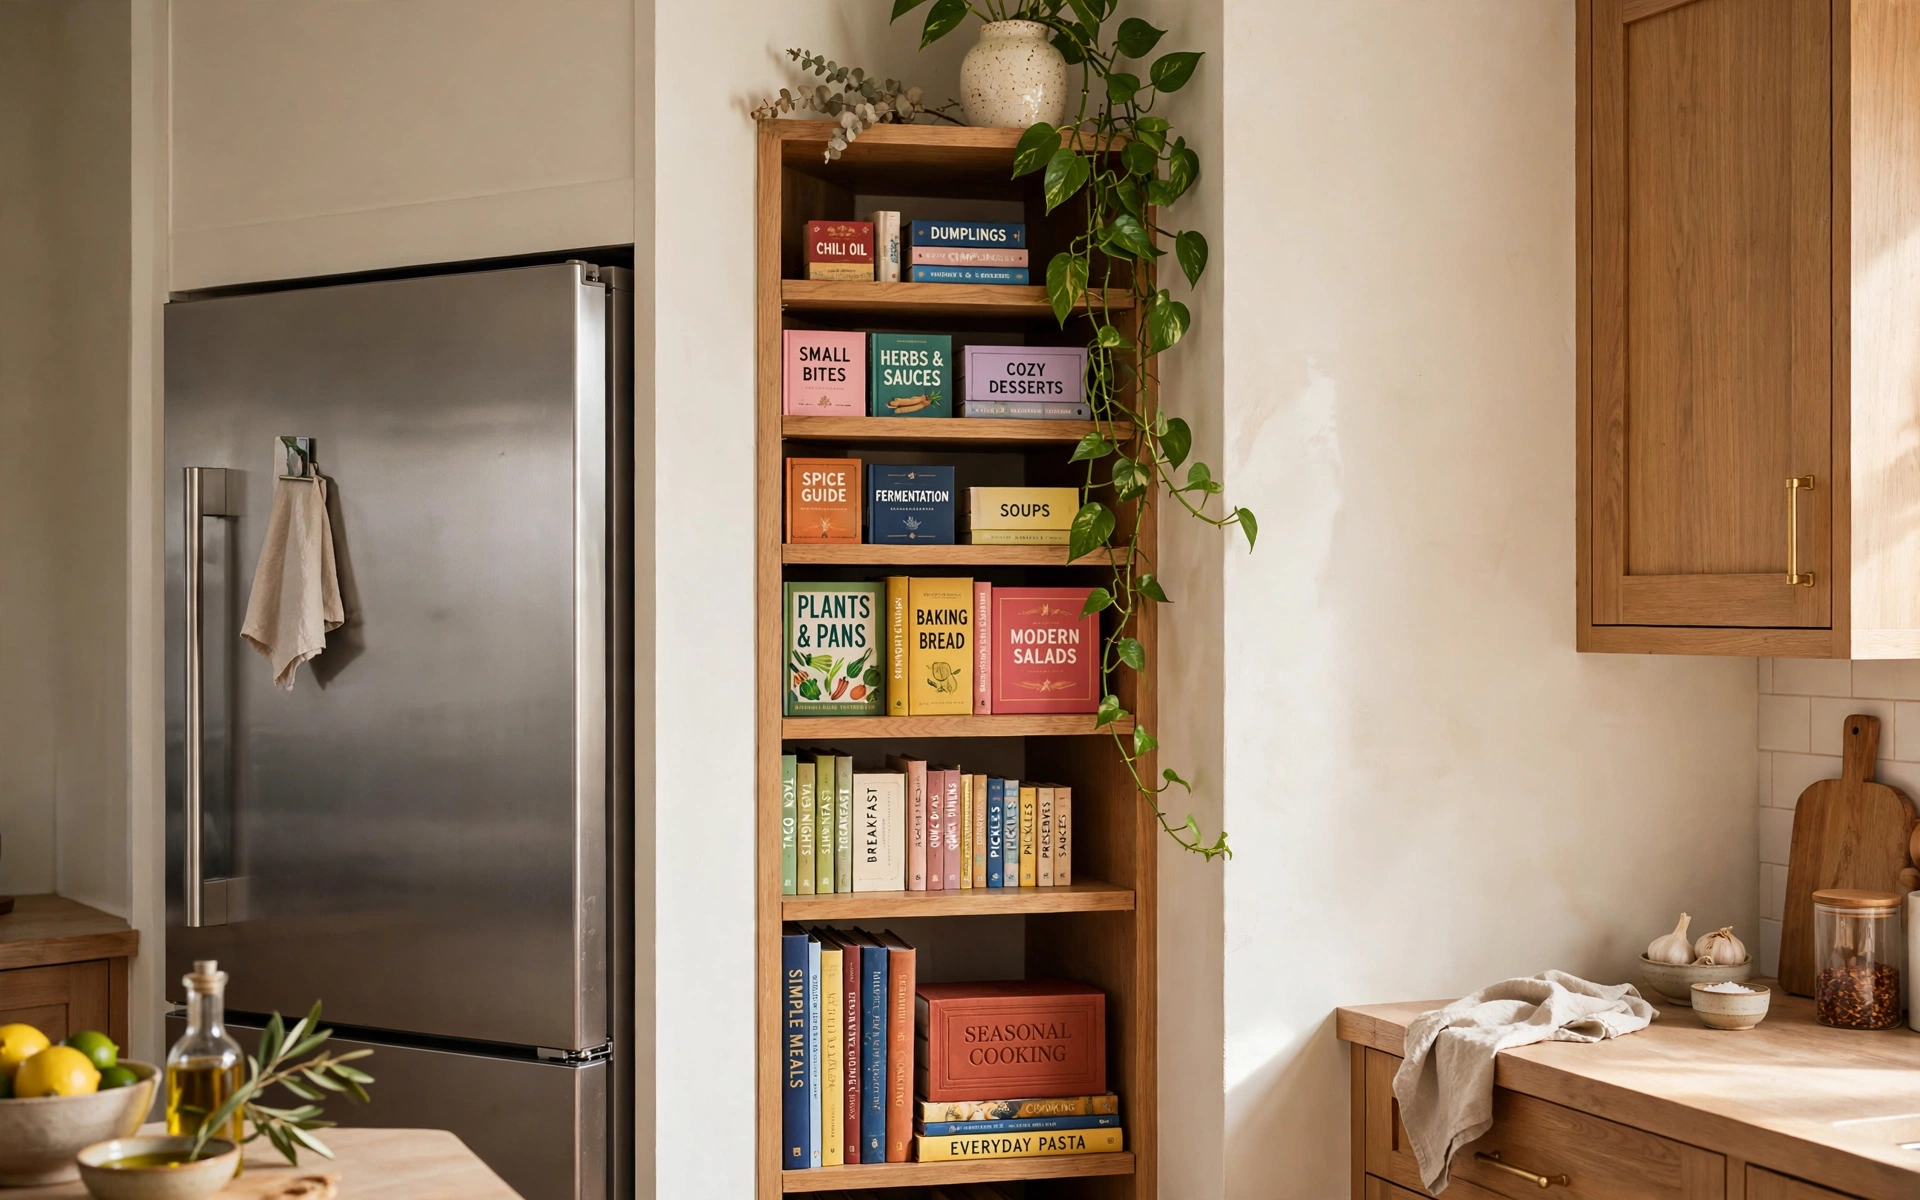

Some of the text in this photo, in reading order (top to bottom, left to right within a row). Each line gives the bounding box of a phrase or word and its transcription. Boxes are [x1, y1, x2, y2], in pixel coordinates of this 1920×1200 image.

[930, 226, 1007, 243] DUMPLINGS
[816, 241, 868, 257] CHILI OIL
[799, 346, 851, 363] SMALL
[880, 350, 944, 367] HERBS &
[802, 367, 846, 382] BITES
[883, 369, 941, 387] SAUCES
[1006, 362, 1046, 377] COZY
[989, 380, 1063, 395] DESSERTS
[802, 472, 846, 487] SPICE
[801, 488, 847, 503] GUIDE
[875, 489, 949, 503] FERMENTATION
[1000, 503, 1050, 518] SOUPS
[797, 594, 870, 620] PLANTS
[916, 609, 968, 626] BAKING
[797, 623, 867, 648] & PANS
[919, 632, 965, 650] BREAD
[1010, 629, 1080, 645] MODERN
[1013, 648, 1077, 665] SALADS
[867, 787, 878, 863] BREAKFAST
[990, 806, 1001, 858] PICKLES
[788, 969, 803, 1089] SIMPLE MEALS
[964, 1021, 1072, 1044] SEASONAL
[968, 1044, 1068, 1066] COOKING
[950, 1134, 1086, 1156] EVERYDAY PASTA
